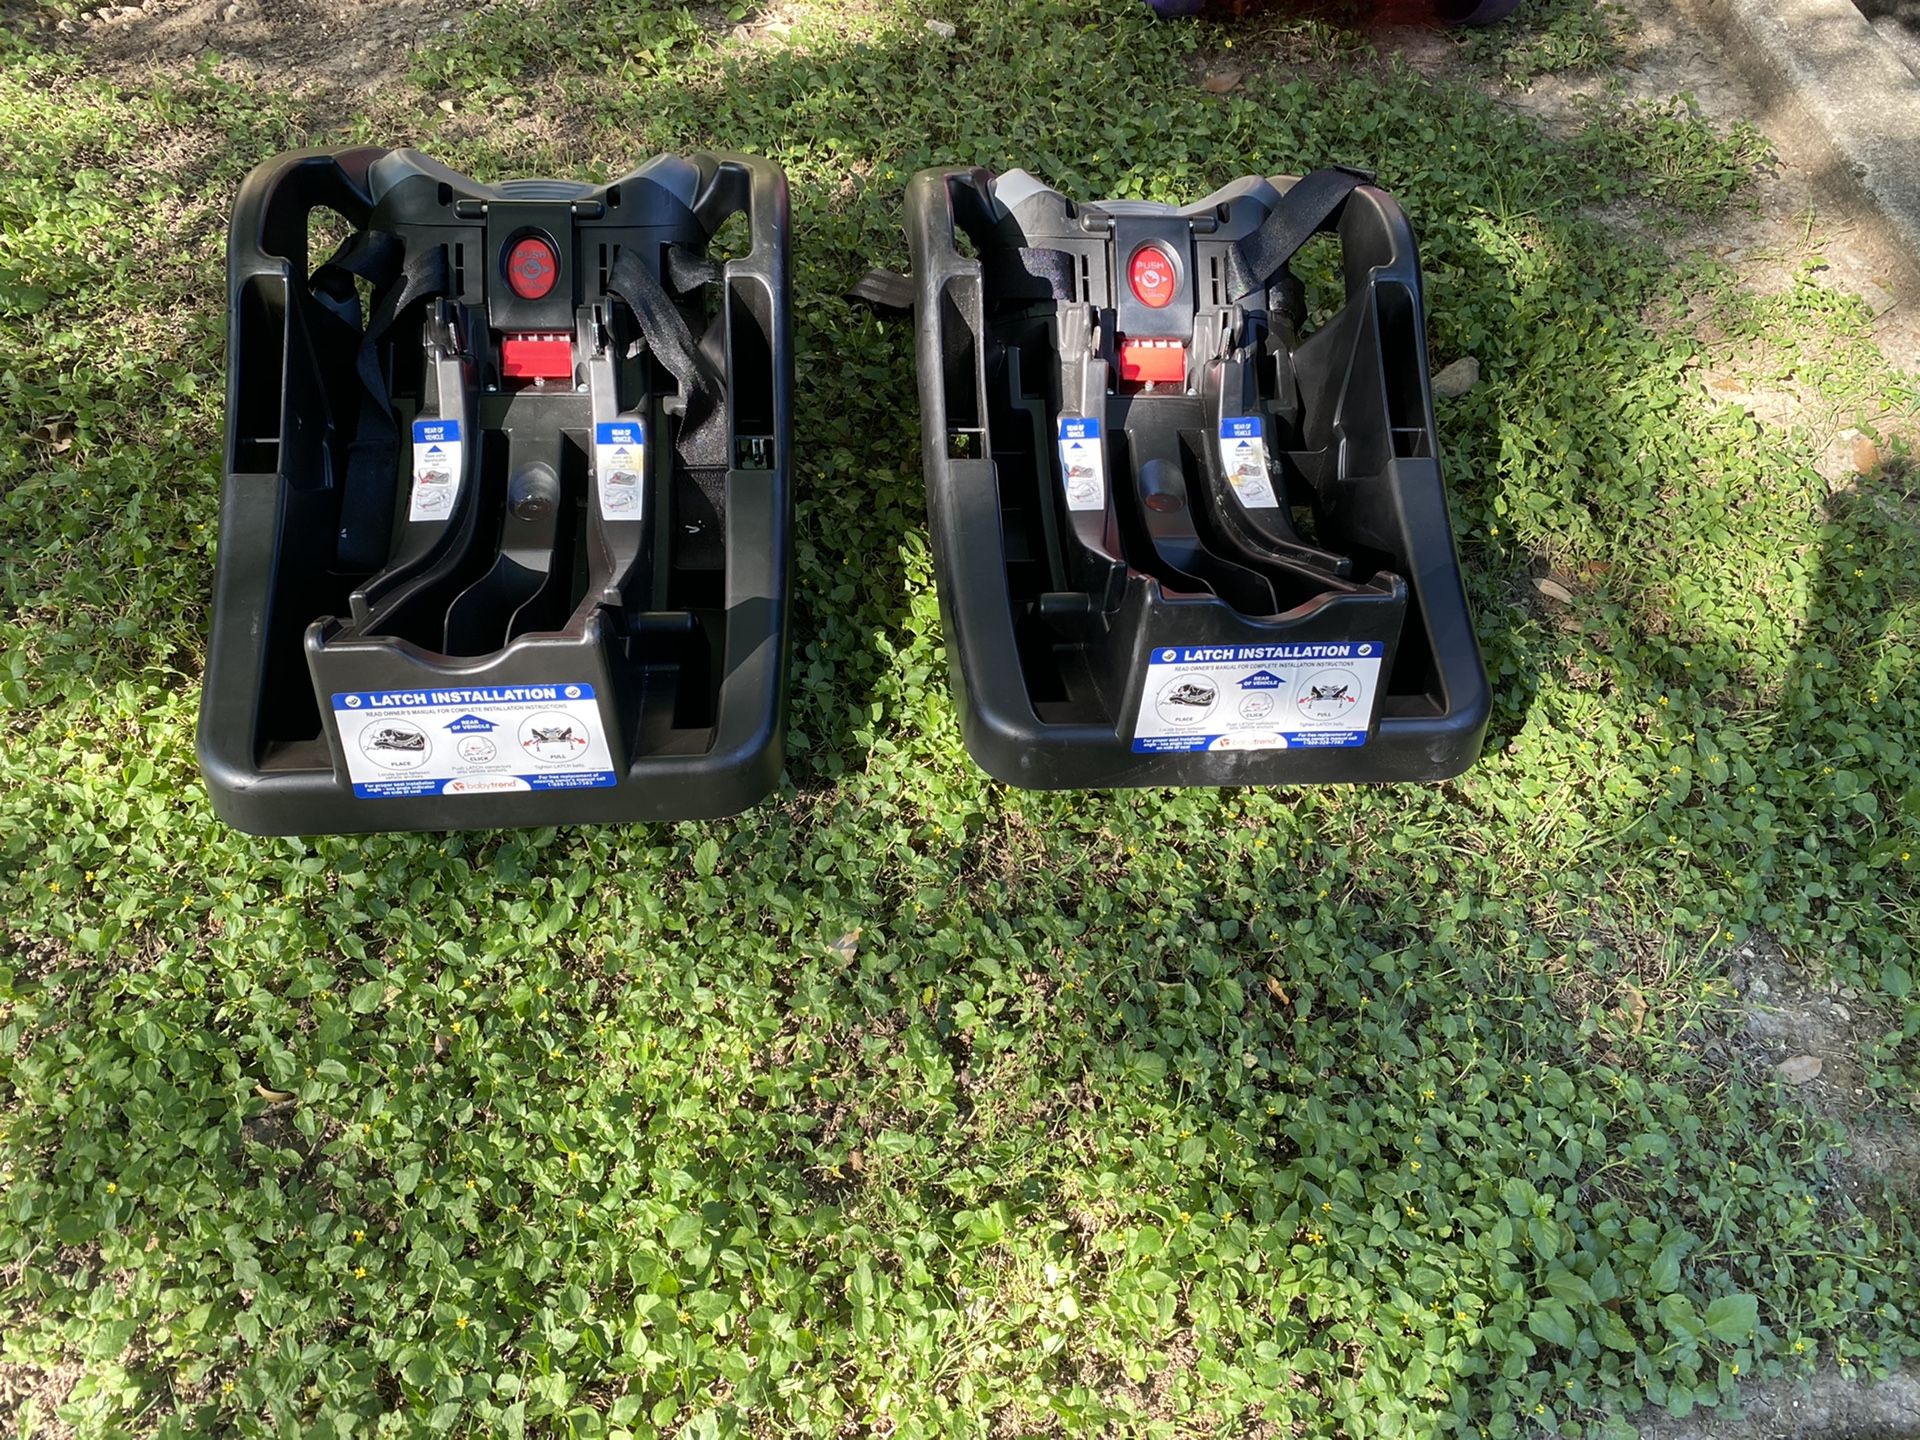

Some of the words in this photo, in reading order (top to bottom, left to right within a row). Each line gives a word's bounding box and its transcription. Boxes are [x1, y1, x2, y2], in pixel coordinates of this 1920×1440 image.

[1136, 261, 1164, 269] PUSH
[1184, 648, 1234, 660] LATCH
[1238, 646, 1350, 659] INSTALLATION
[370, 692, 428, 706] LATCH
[431, 688, 556, 704] INSTALLATION
[467, 780, 517, 790] babytrend
